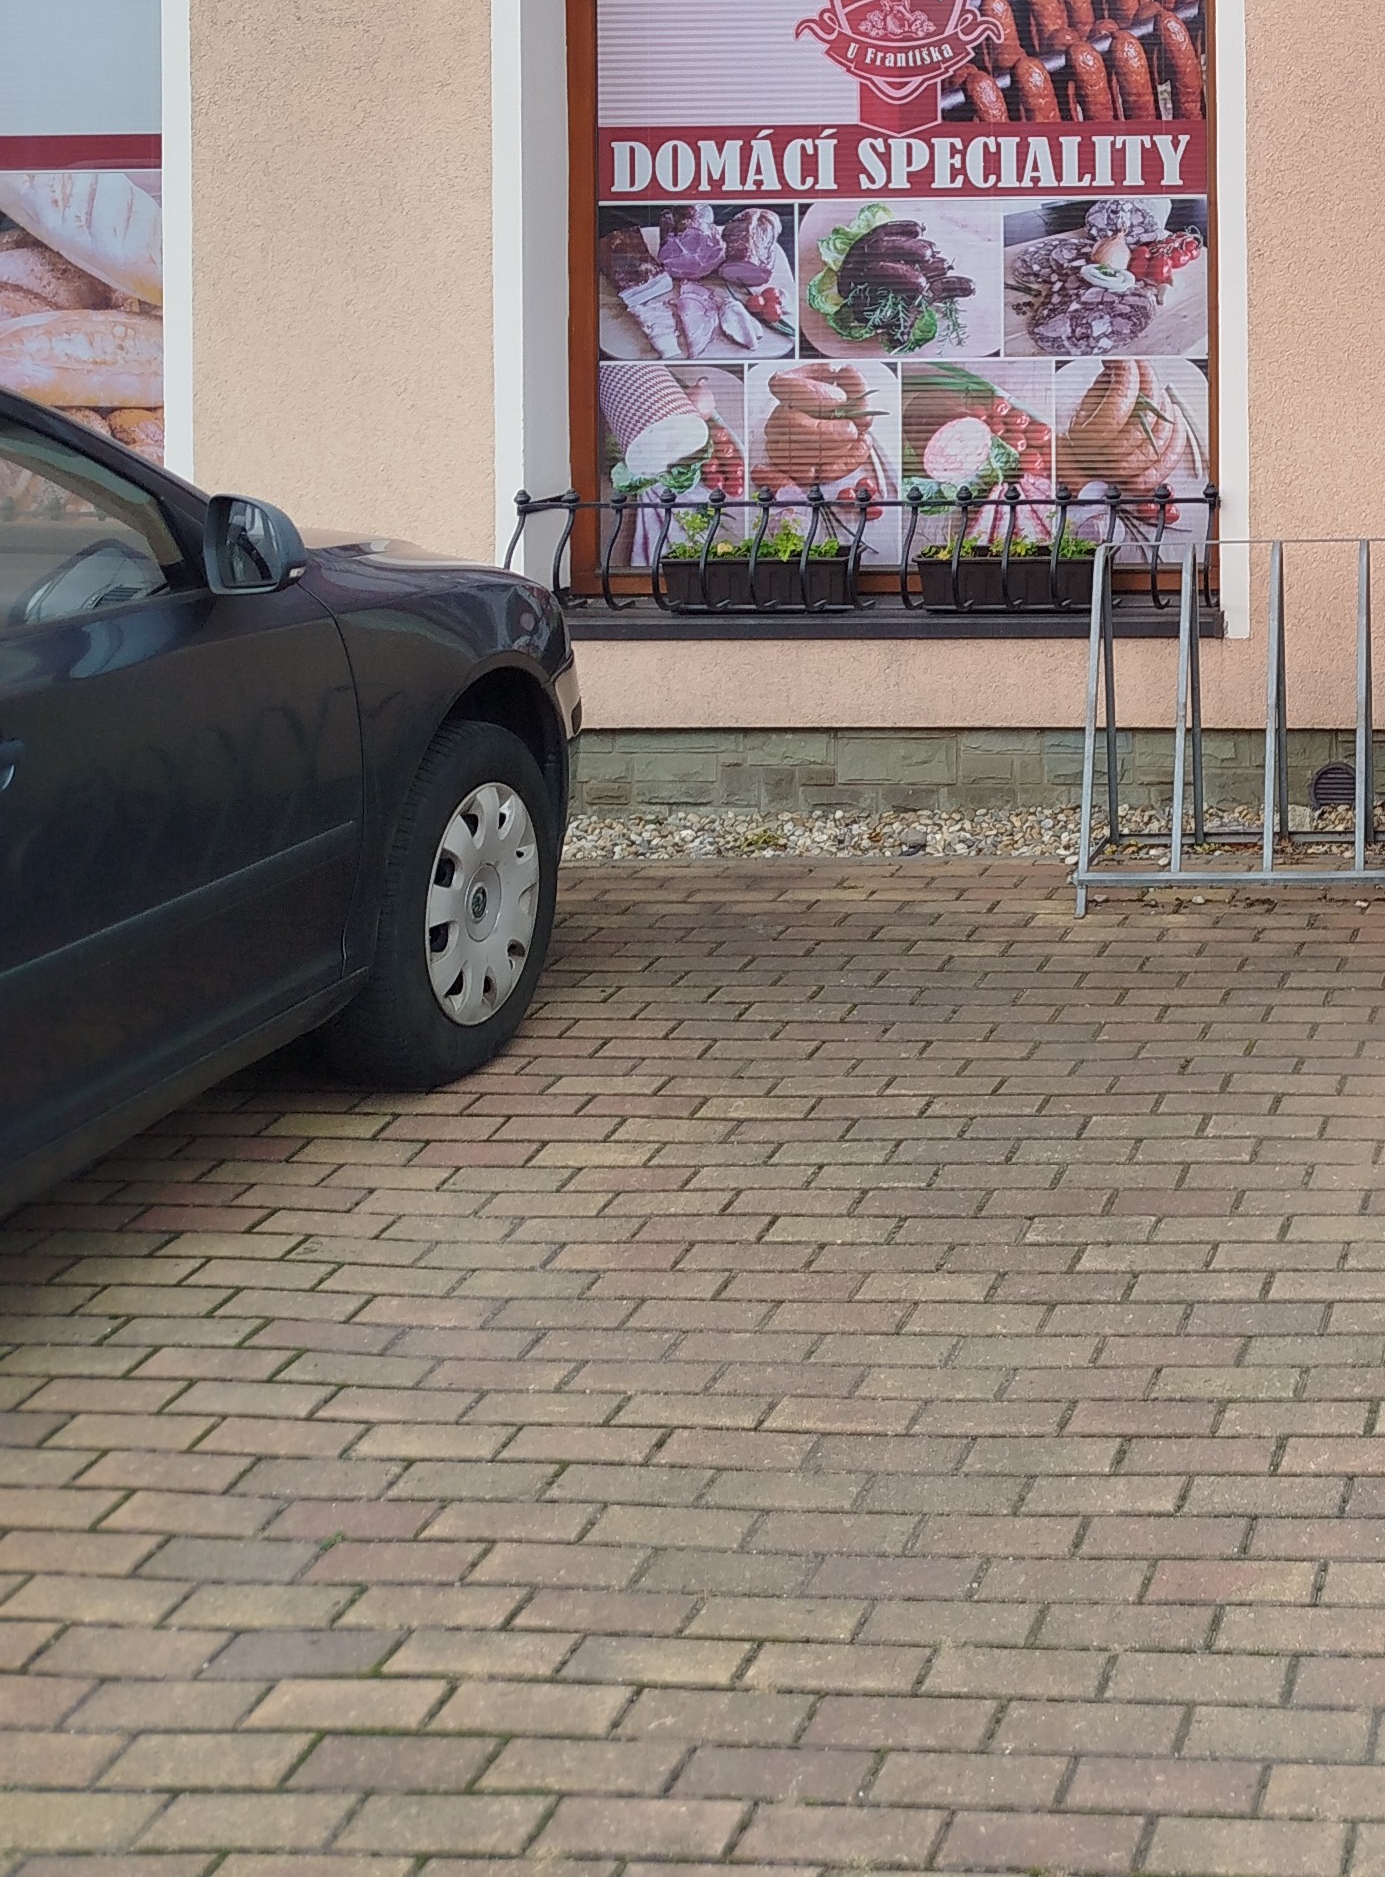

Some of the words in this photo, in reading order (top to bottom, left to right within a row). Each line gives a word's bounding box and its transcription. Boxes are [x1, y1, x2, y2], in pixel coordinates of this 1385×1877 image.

[847, 42, 859, 60] U
[864, 43, 954, 67] Františka
[610, 128, 838, 192] DOMÁCÍ
[857, 134, 1192, 190] SPECIALITY
